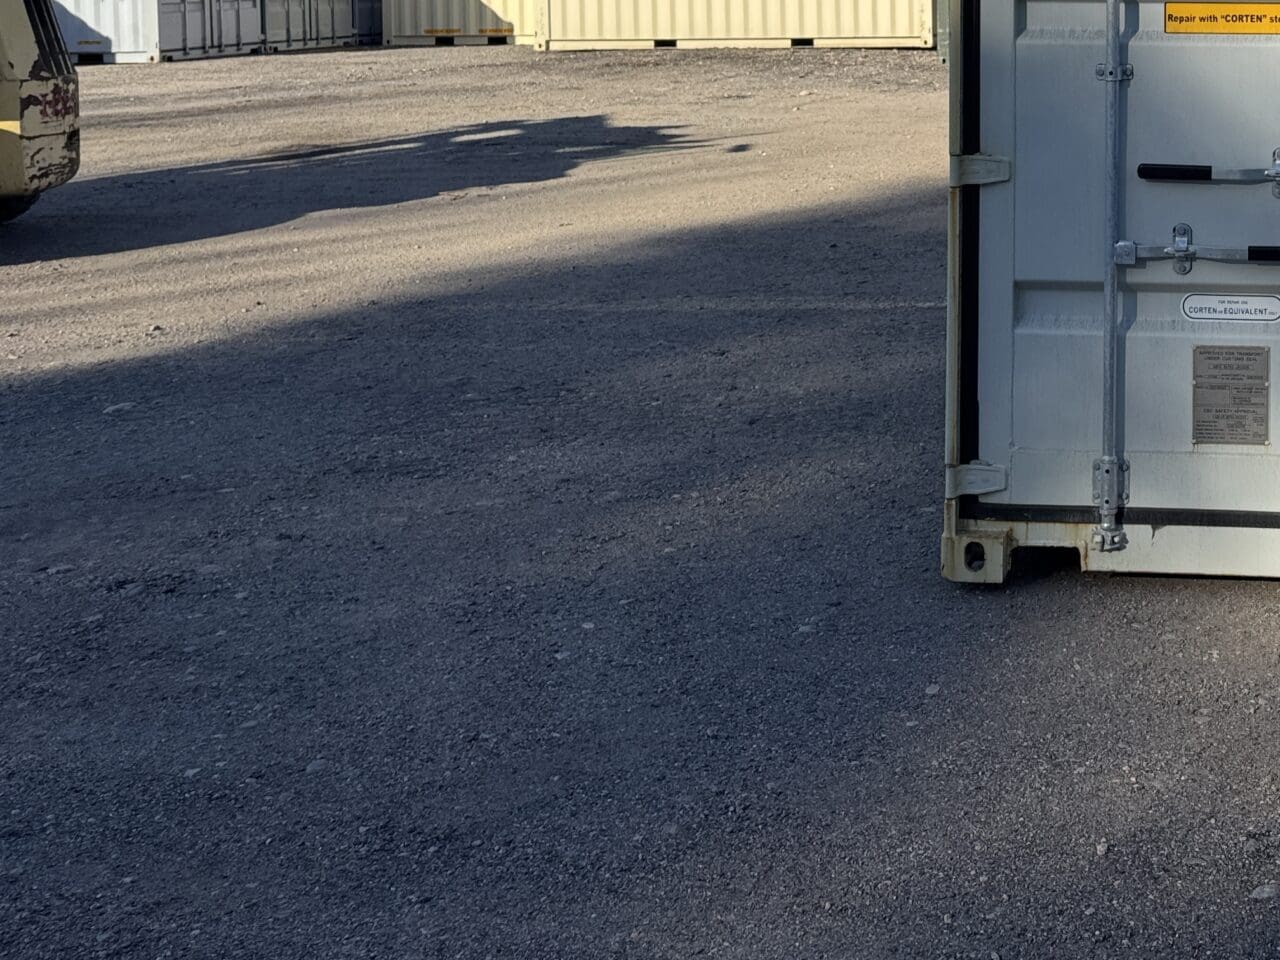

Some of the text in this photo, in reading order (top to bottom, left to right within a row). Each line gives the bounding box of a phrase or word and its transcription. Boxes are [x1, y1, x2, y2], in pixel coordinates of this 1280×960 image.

[1167, 13, 1196, 24] Repair
[1199, 14, 1218, 23] with
[1188, 306, 1218, 314] CORTEN
[1223, 307, 1269, 316] EQUIVALENT
